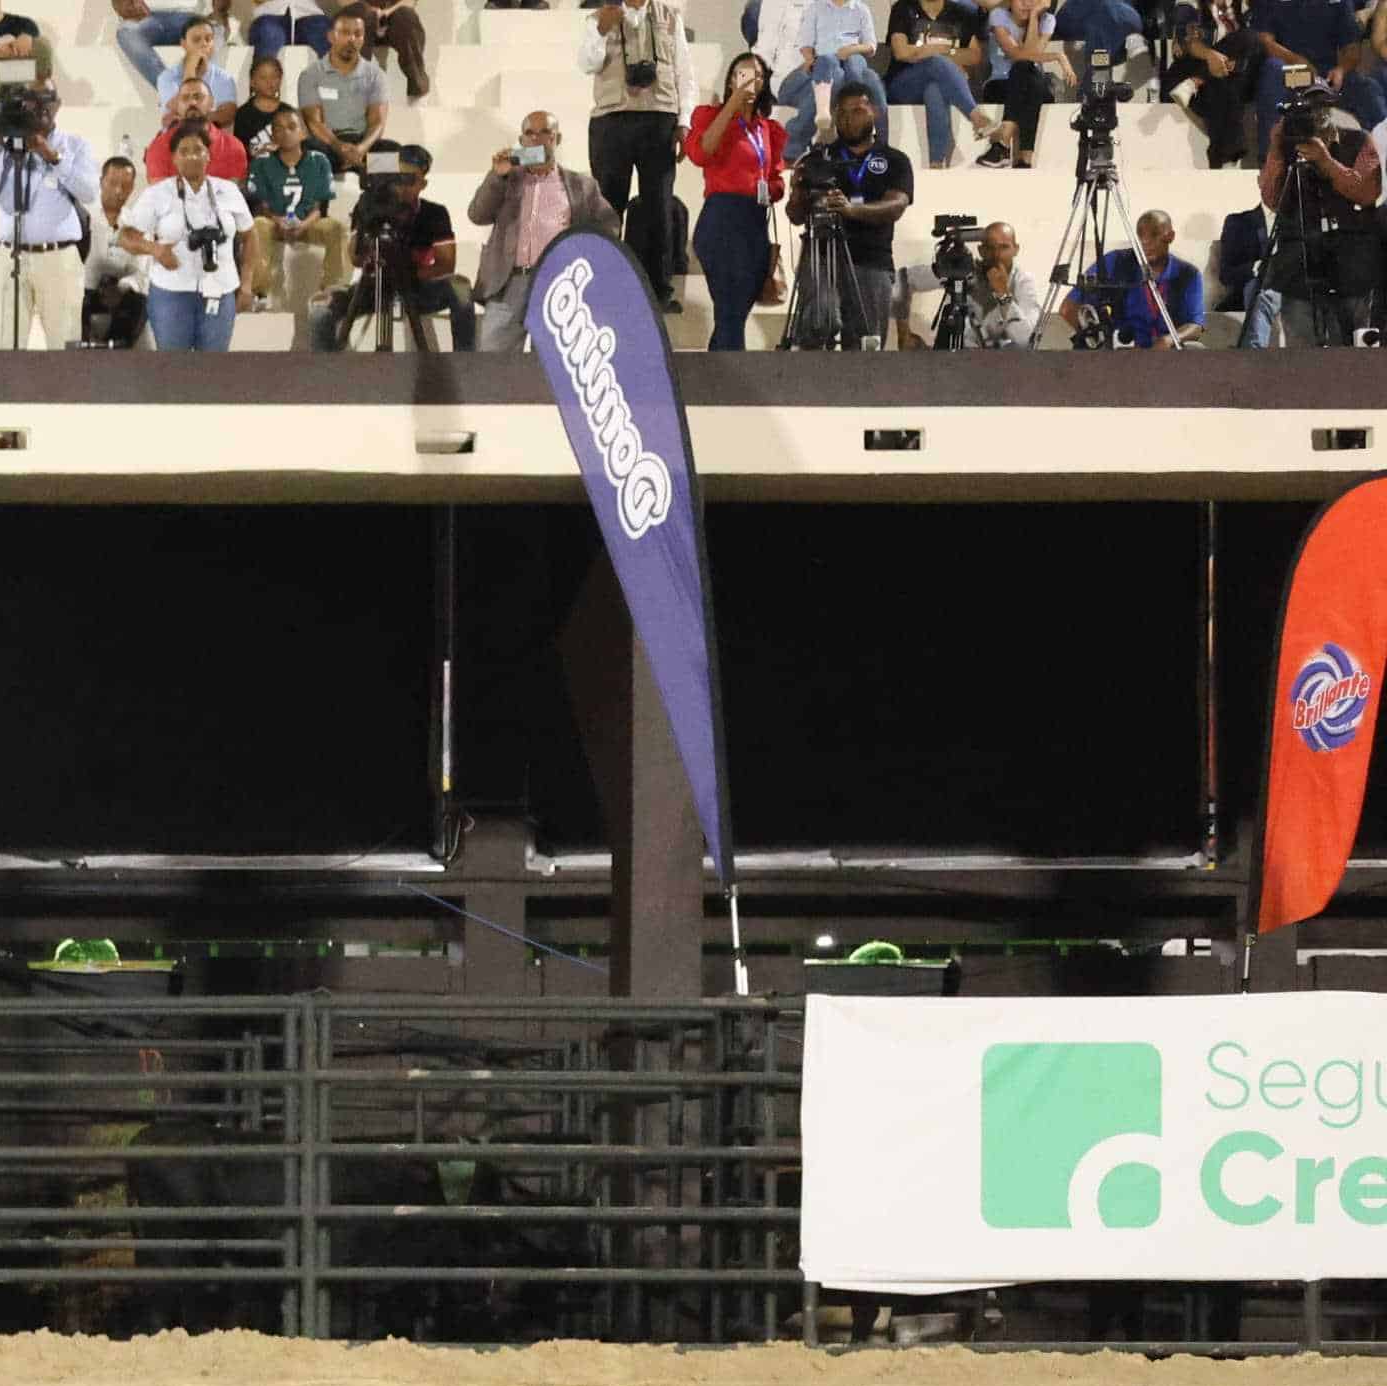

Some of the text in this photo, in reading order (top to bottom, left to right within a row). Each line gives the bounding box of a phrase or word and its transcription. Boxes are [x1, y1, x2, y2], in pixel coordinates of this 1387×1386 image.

[283, 185, 303, 212] 7
[1293, 671, 1372, 730] Brillante
[1204, 1040, 1387, 1129] Seg
[1200, 1130, 1387, 1226] Cre
